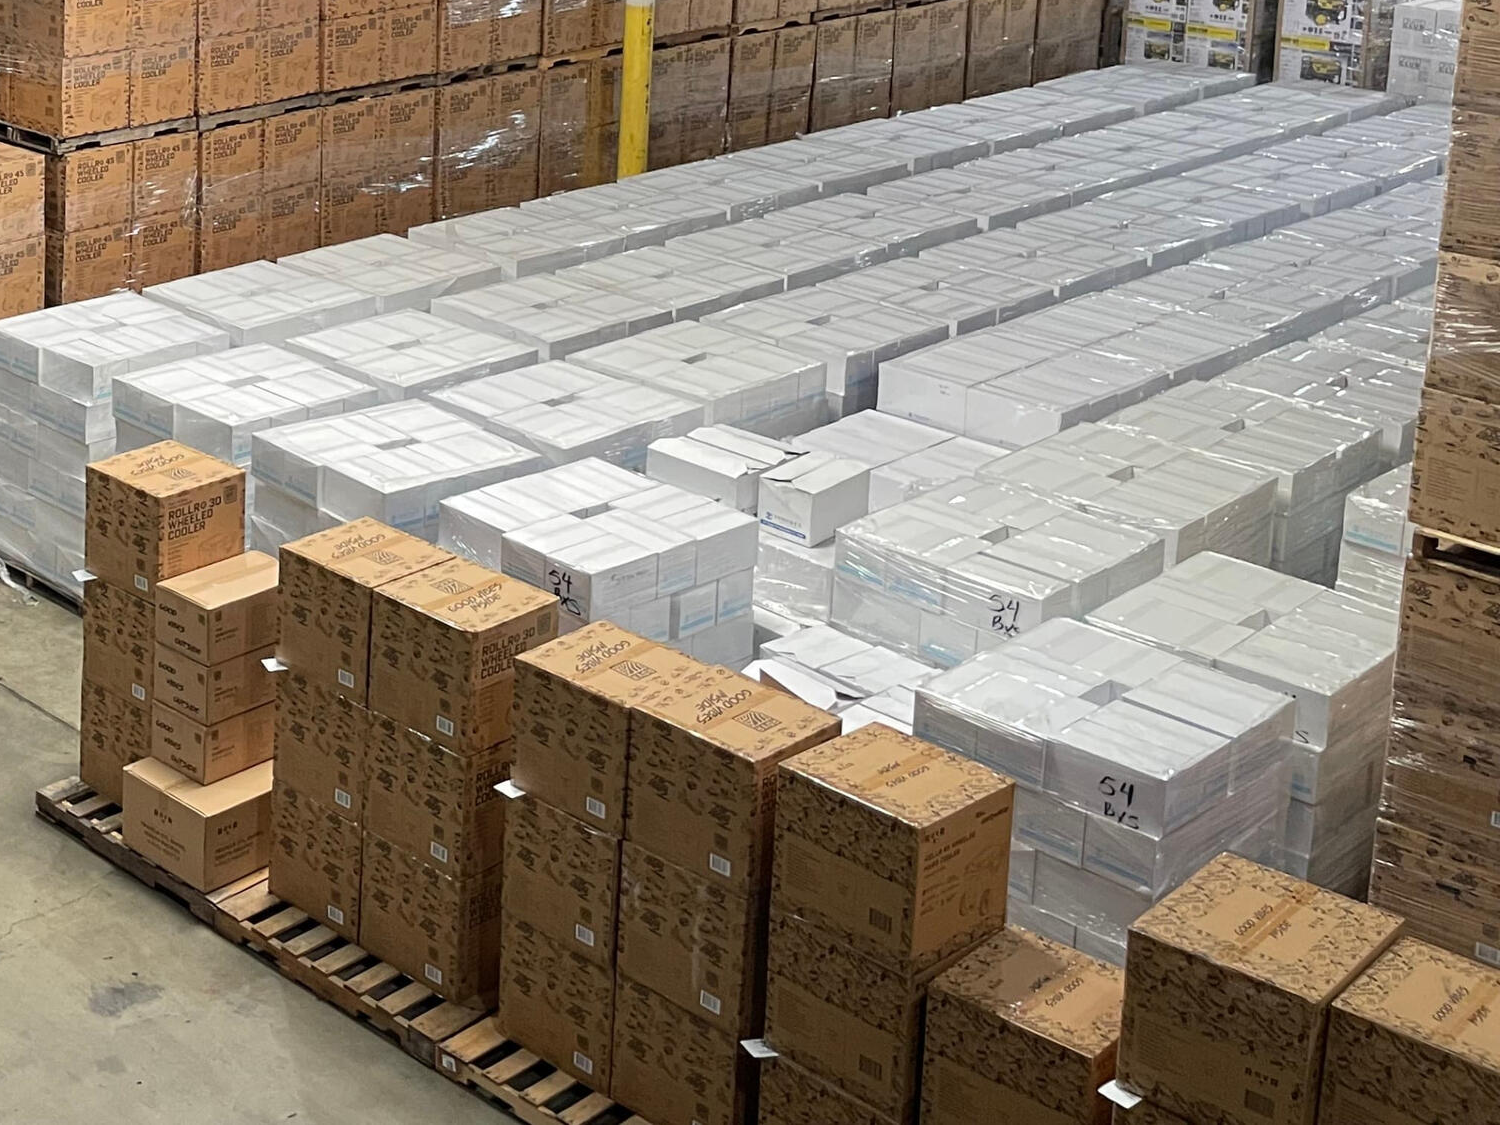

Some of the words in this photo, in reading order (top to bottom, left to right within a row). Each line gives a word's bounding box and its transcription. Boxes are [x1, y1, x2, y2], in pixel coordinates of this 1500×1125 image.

[168, 509, 213, 530] WHEELED
[168, 521, 206, 540] COOLER
[549, 570, 572, 593] 54
[988, 594, 1020, 621] 54
[481, 642, 526, 667] WHEELED
[603, 640, 631, 660] GOOD
[723, 689, 752, 708] GOOD
[1100, 776, 1135, 807] 54
